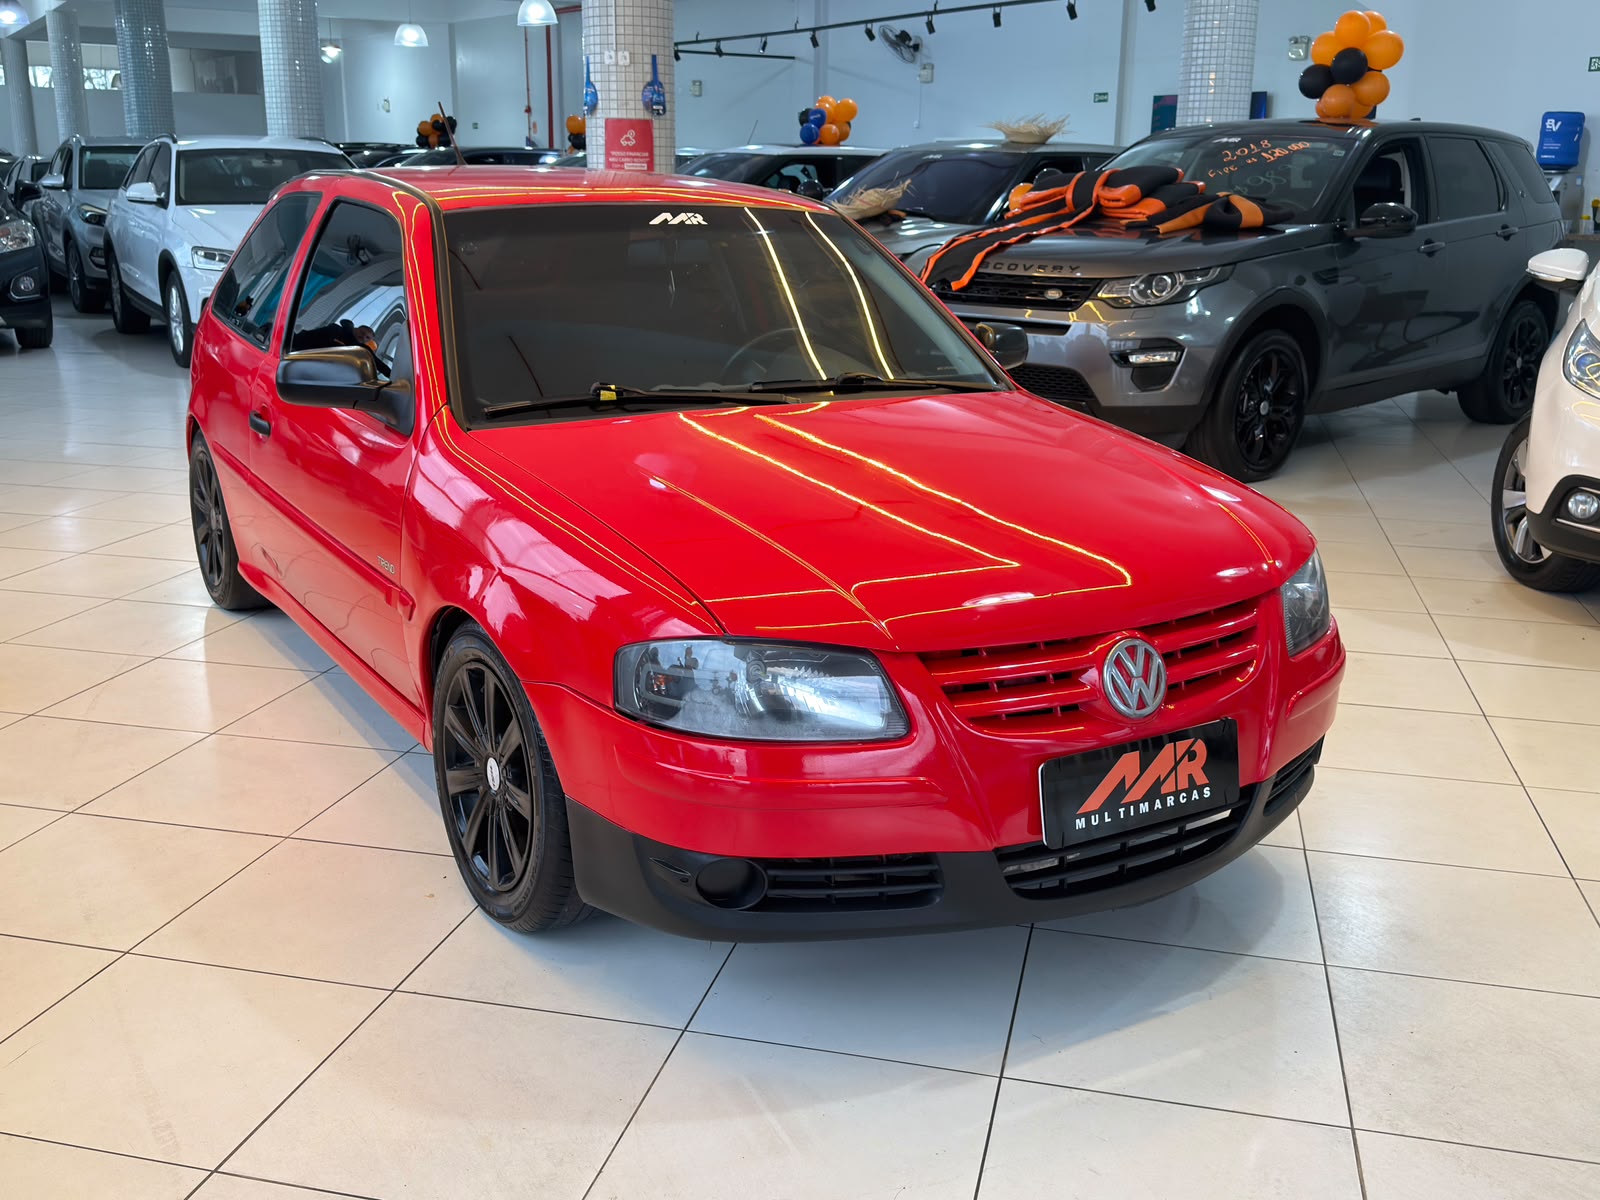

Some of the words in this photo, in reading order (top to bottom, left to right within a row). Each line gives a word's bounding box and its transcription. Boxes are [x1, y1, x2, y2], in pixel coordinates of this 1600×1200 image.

[1545, 118, 1562, 132] BV
[1222, 140, 1271, 162] 2018
[979, 261, 1080, 273] SCOVERY
[377, 555, 395, 574] TREND
[1075, 787, 1211, 830] MULTIMARCAS
